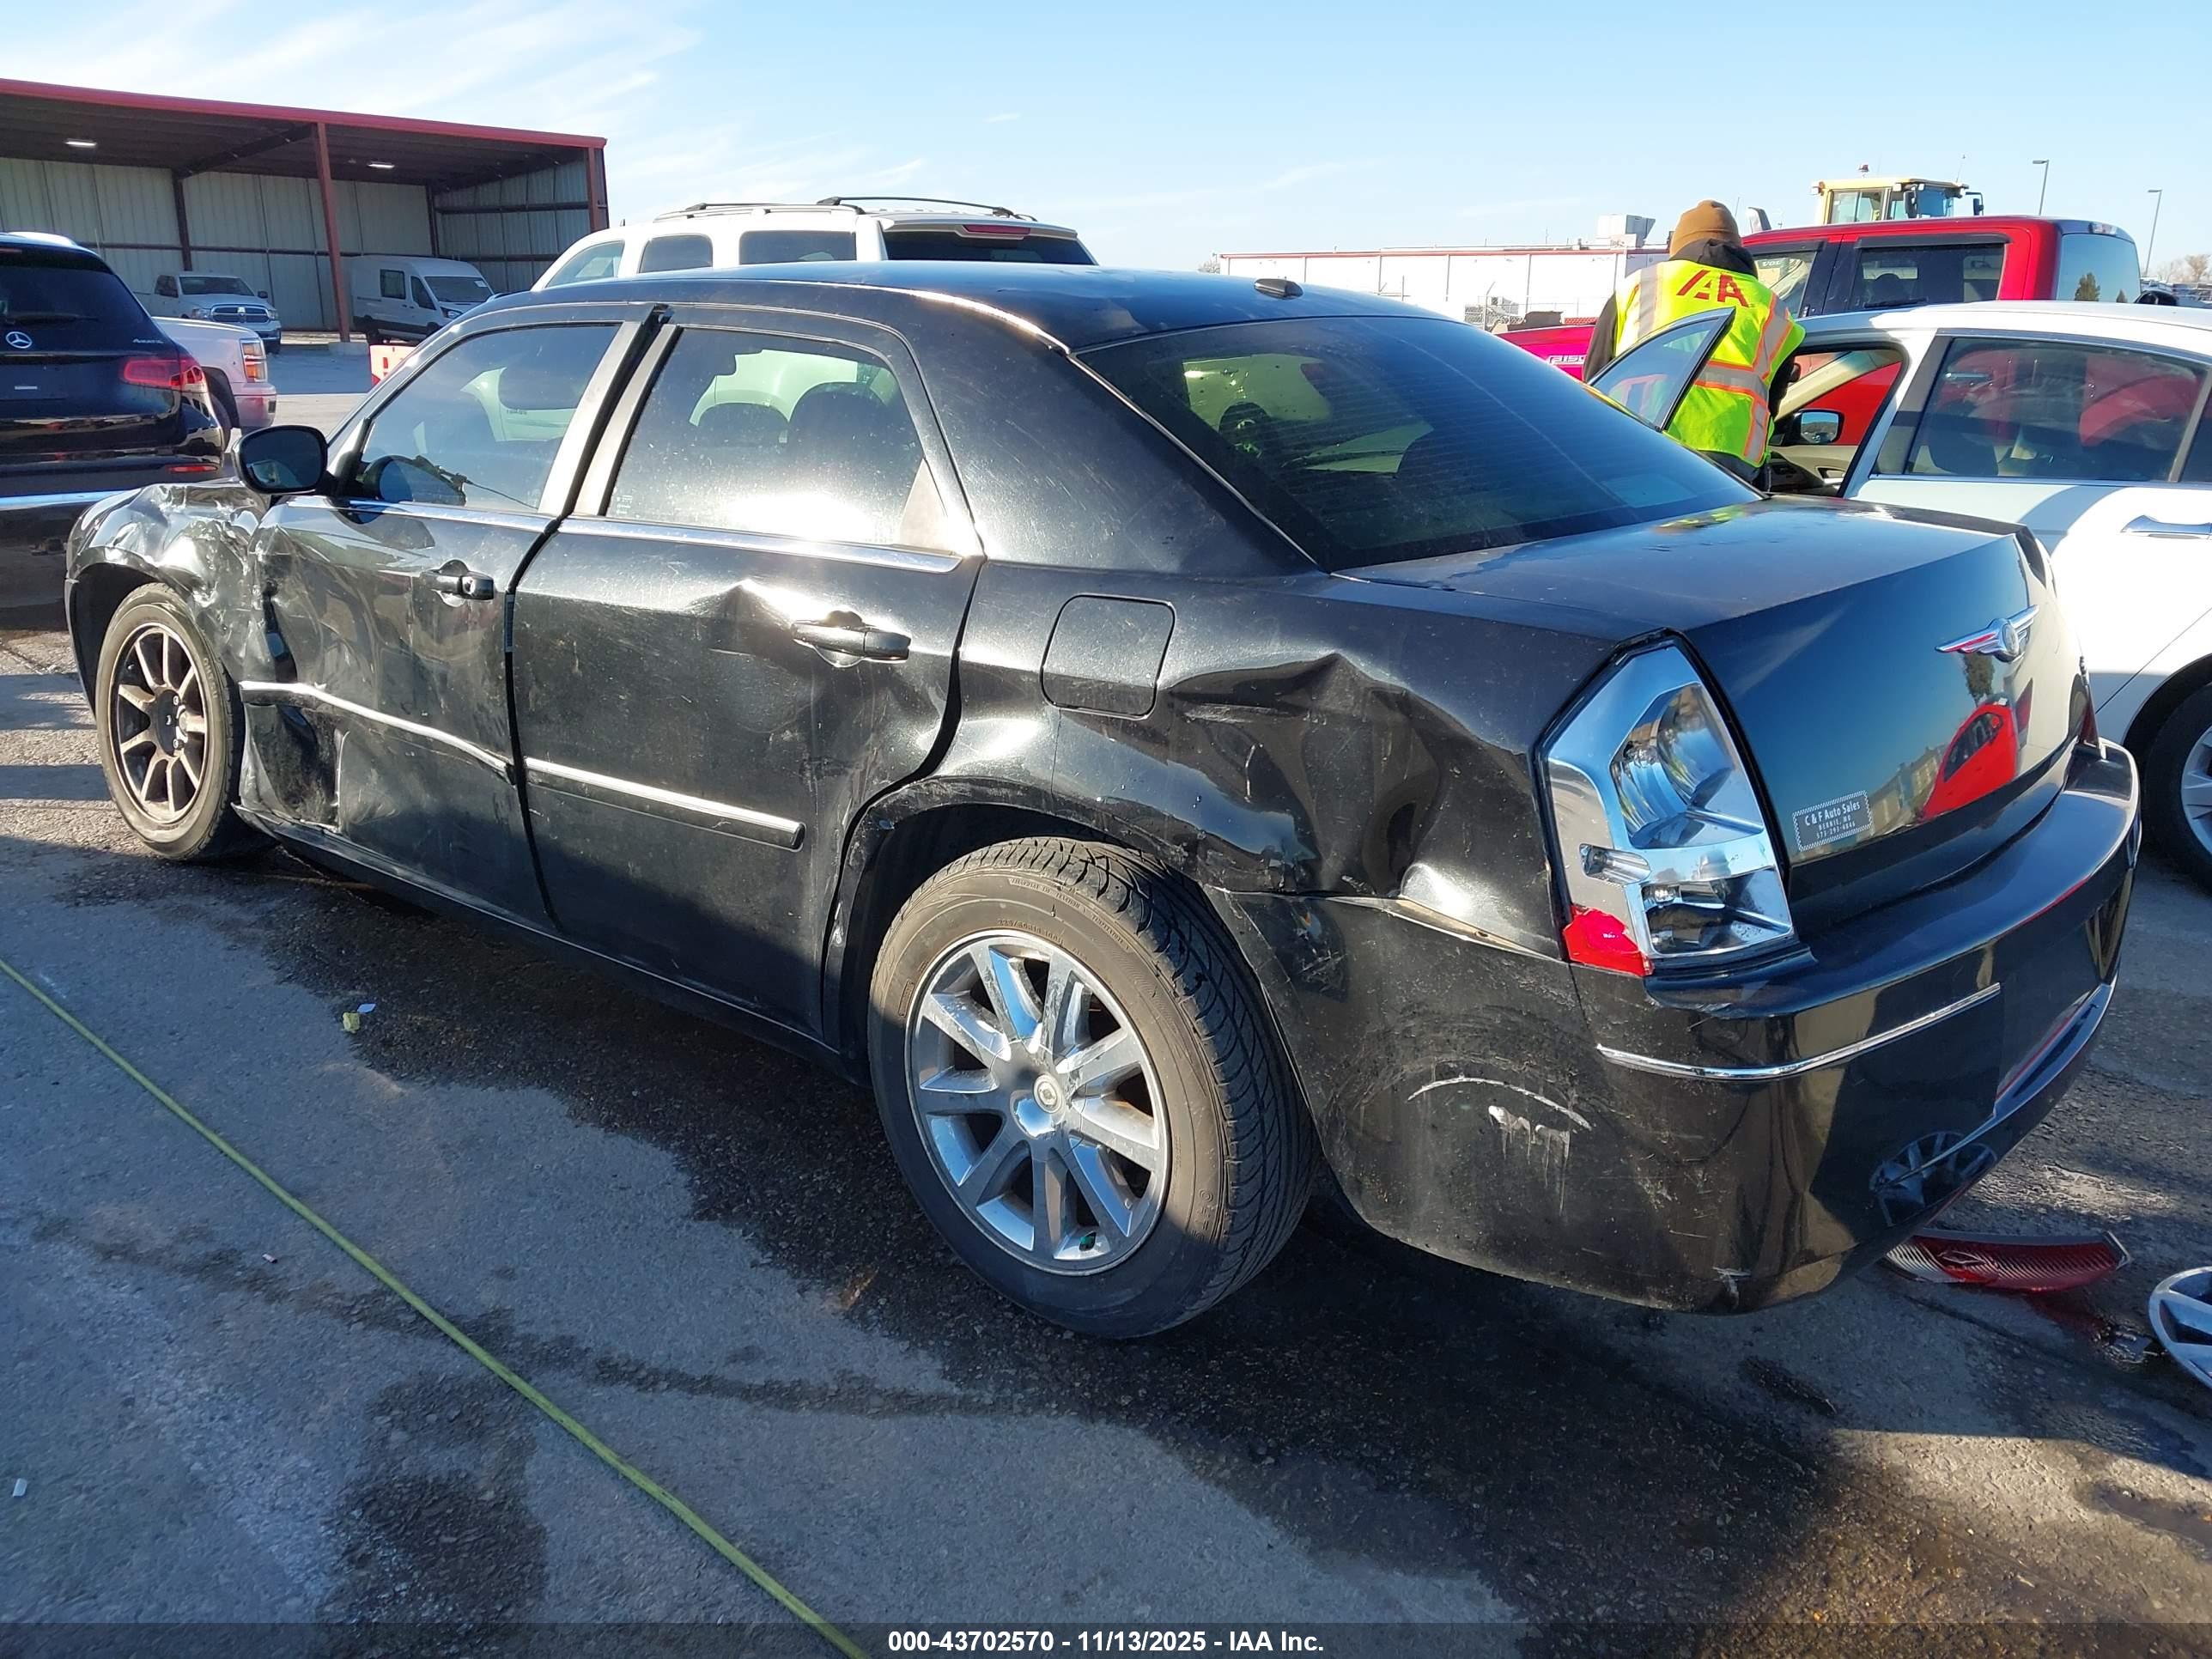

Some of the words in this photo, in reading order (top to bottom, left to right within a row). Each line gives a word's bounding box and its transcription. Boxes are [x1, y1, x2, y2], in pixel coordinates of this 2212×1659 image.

[1805, 815, 1811, 826] C
[1811, 813, 1817, 824] &
[1818, 811, 1823, 822] F
[1825, 807, 1841, 820] Auto
[1842, 800, 1861, 814] Sales
